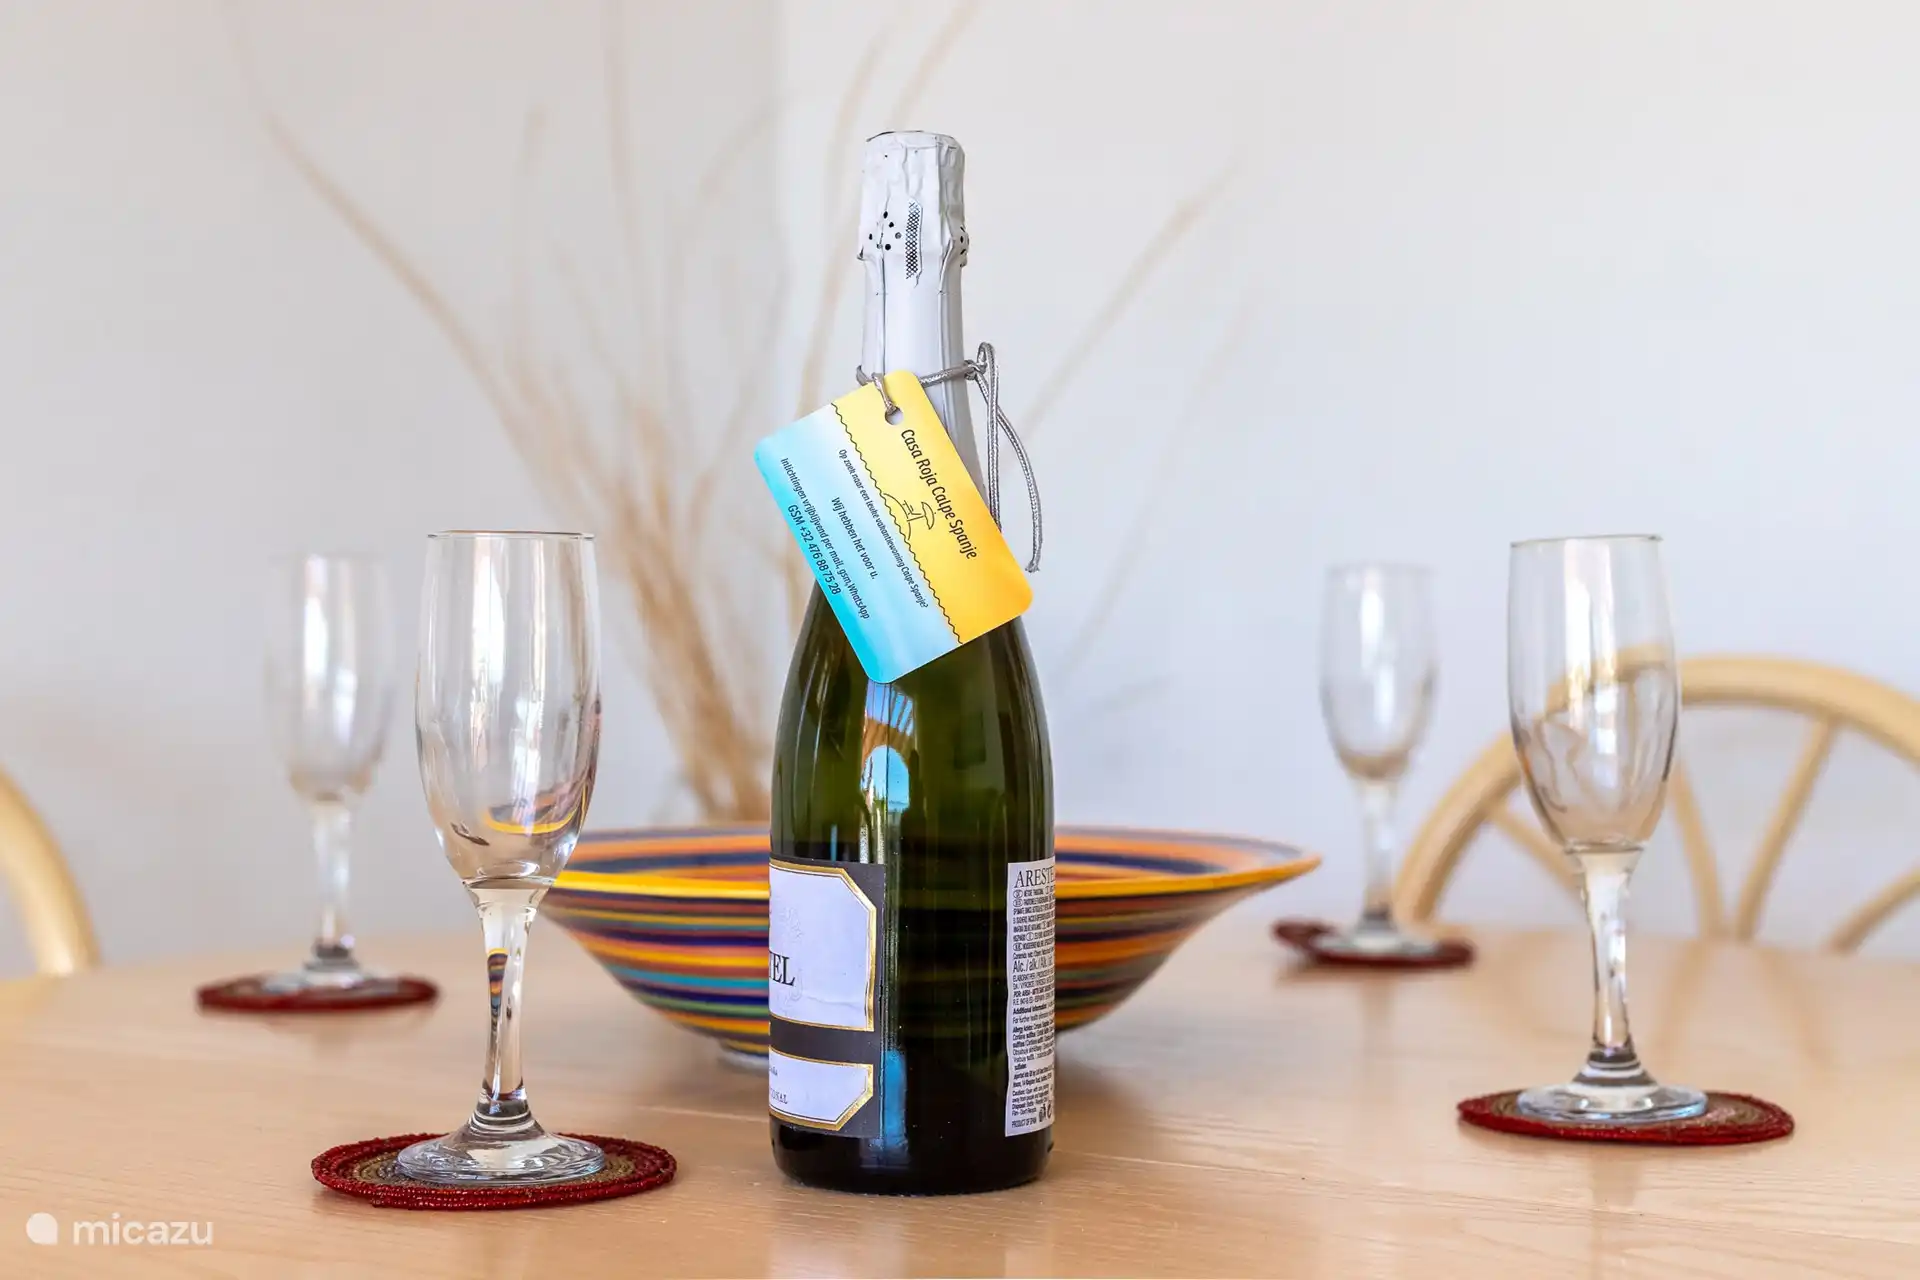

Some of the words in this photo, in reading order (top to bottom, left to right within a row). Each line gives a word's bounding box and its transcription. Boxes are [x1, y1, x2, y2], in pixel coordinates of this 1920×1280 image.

[900, 429, 923, 459] Casa
[915, 458, 938, 487] Roja
[931, 486, 956, 520] Calpe
[949, 519, 977, 560] Spanje
[831, 497, 845, 512] Wij
[787, 504, 806, 526] GSM
[802, 498, 829, 539] vrijblijvend
[820, 538, 834, 550] per
[837, 510, 858, 540] hebben
[838, 449, 848, 459] Op
[843, 459, 856, 475] zoek
[851, 473, 864, 489] naar
[859, 489, 870, 501] een
[865, 500, 880, 519] leuke
[875, 517, 905, 568] vakantiewoning
[901, 566, 915, 585] Calpe
[910, 583, 929, 608] Spanje?
[800, 526, 814, 543] +32
[808, 543, 823, 559] 476
[852, 538, 866, 553] het
[816, 559, 830, 572] 88
[860, 551, 875, 570] voor
[822, 570, 836, 583] 75
[869, 570, 878, 580] u.
[827, 582, 842, 595] 28
